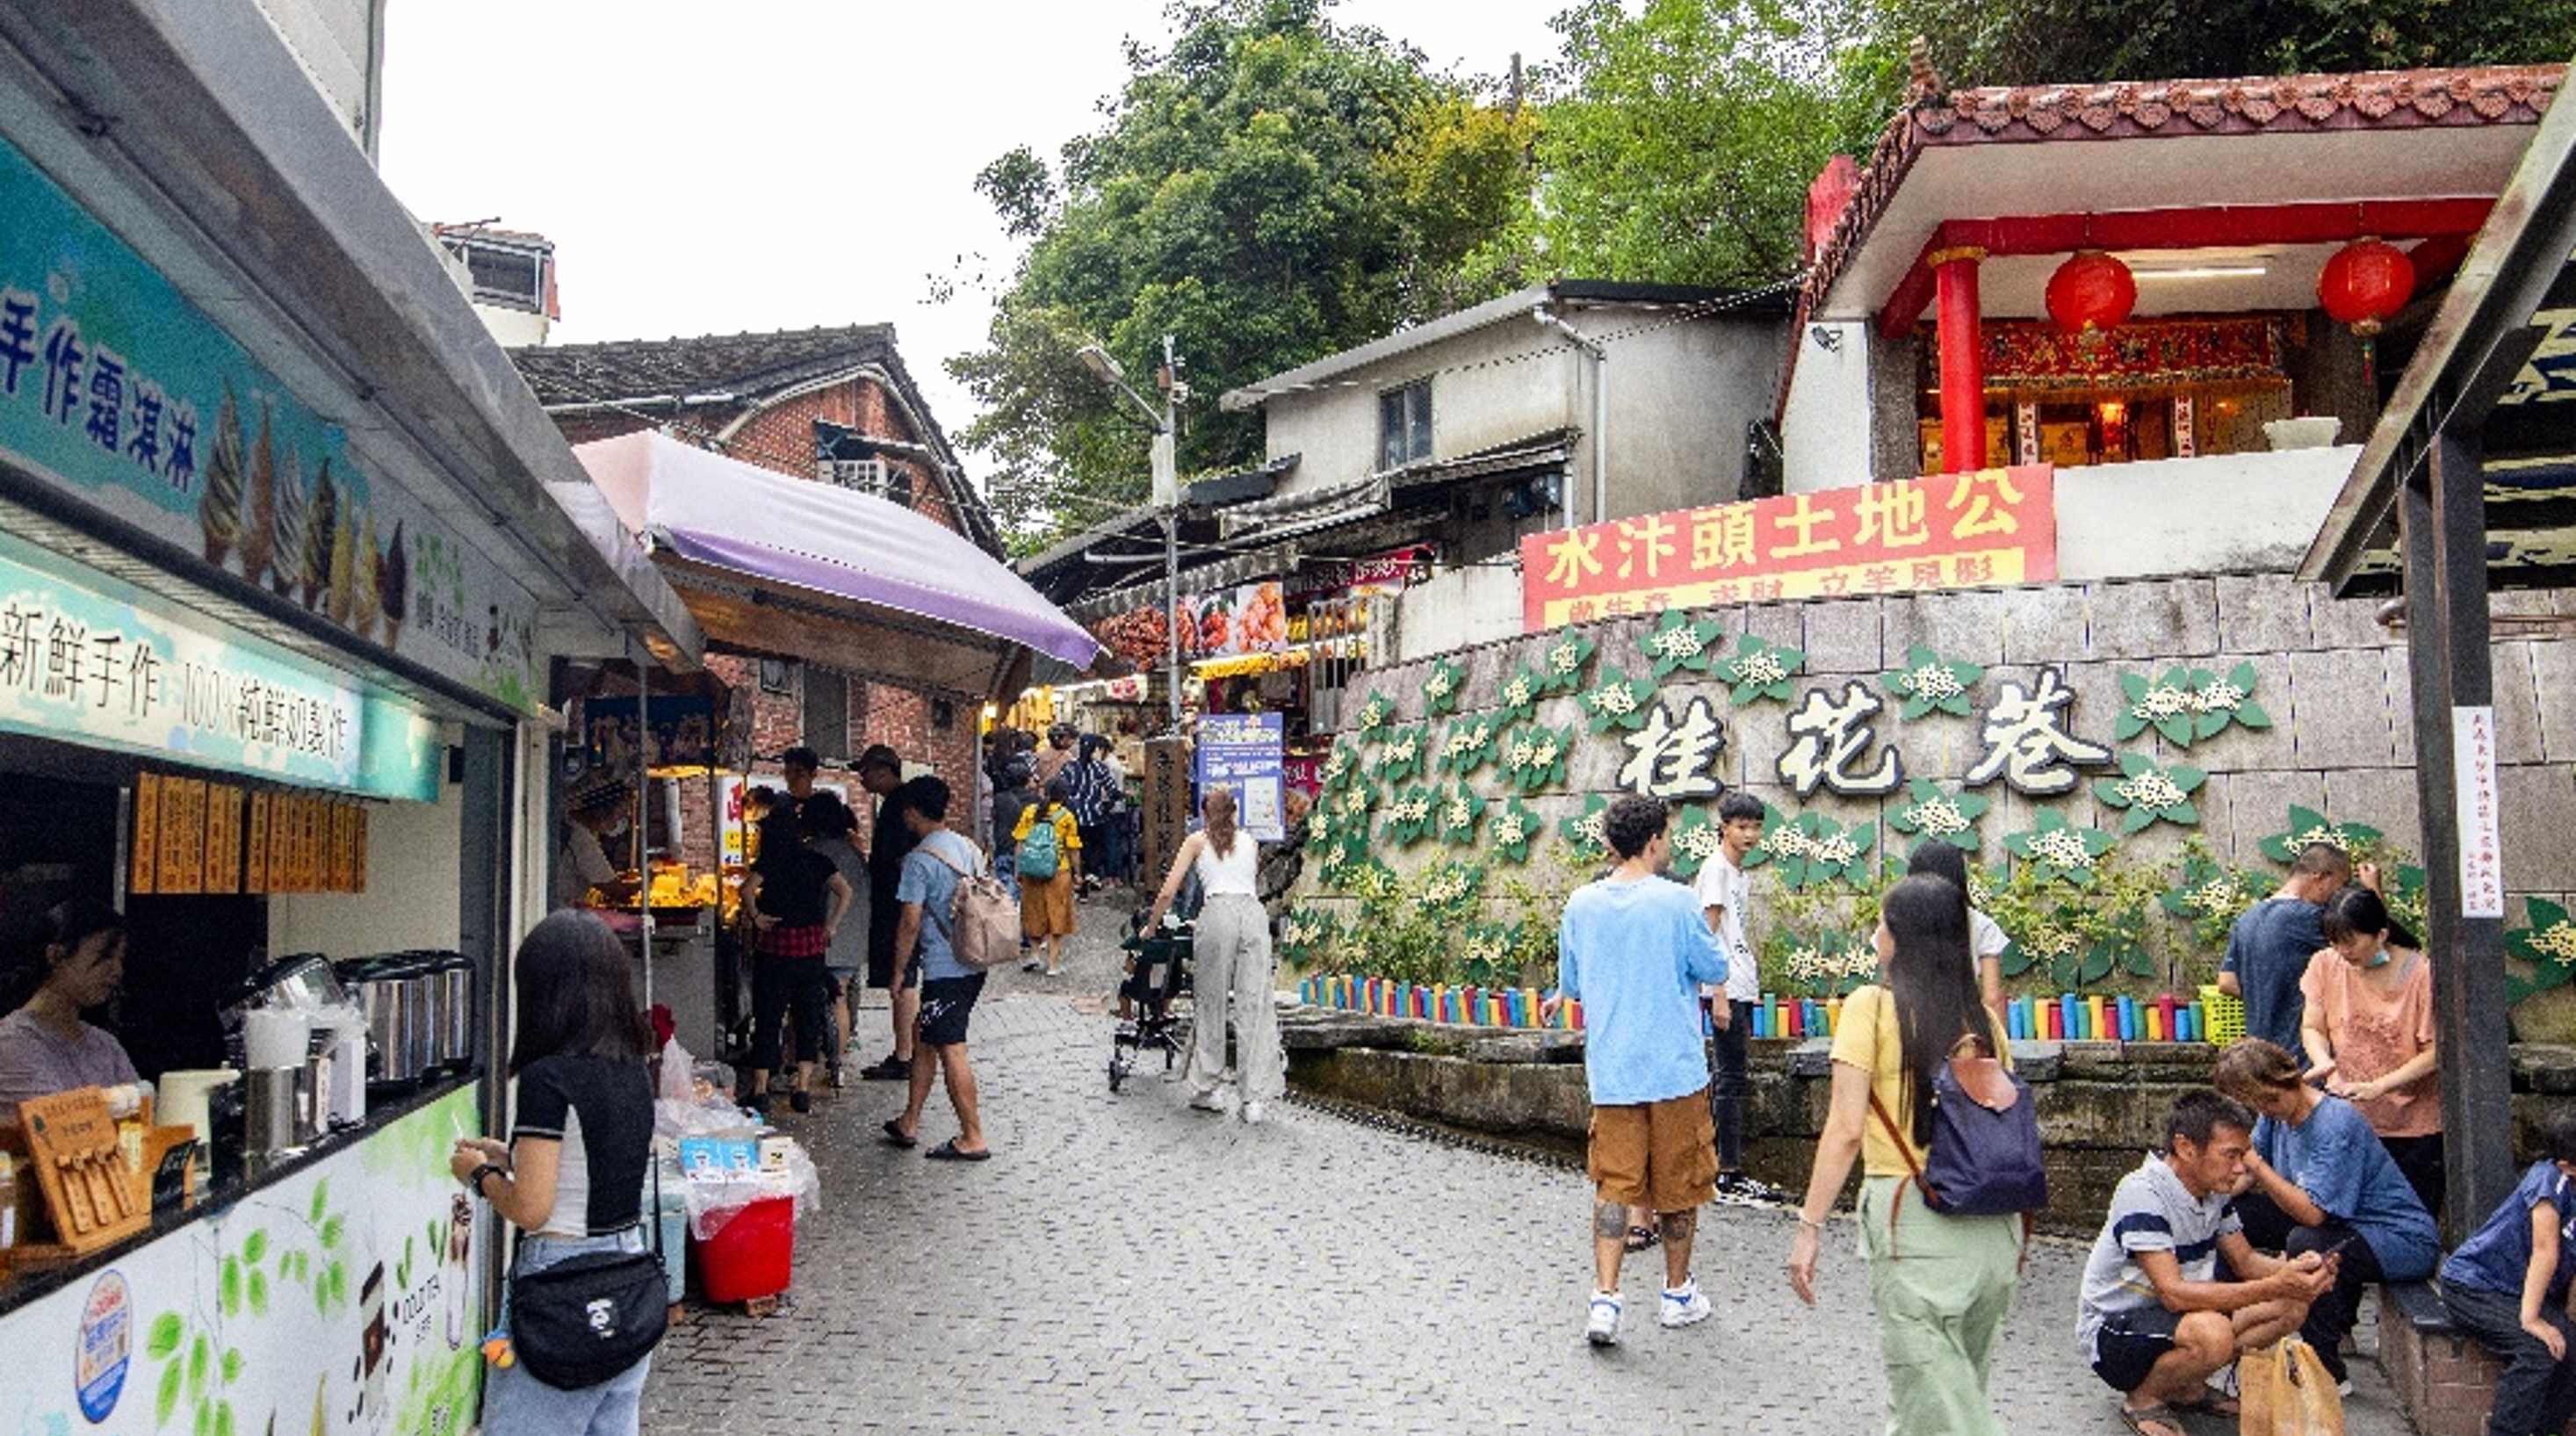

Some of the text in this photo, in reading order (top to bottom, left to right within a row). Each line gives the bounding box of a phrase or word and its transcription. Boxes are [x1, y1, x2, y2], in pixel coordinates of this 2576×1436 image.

[0, 299, 196, 493] 手作霜淇淋
[1546, 468, 2024, 588] 水汴頭土地公
[0, 603, 160, 718] 新鮮手作
[1619, 668, 2112, 798] 桂花巷
